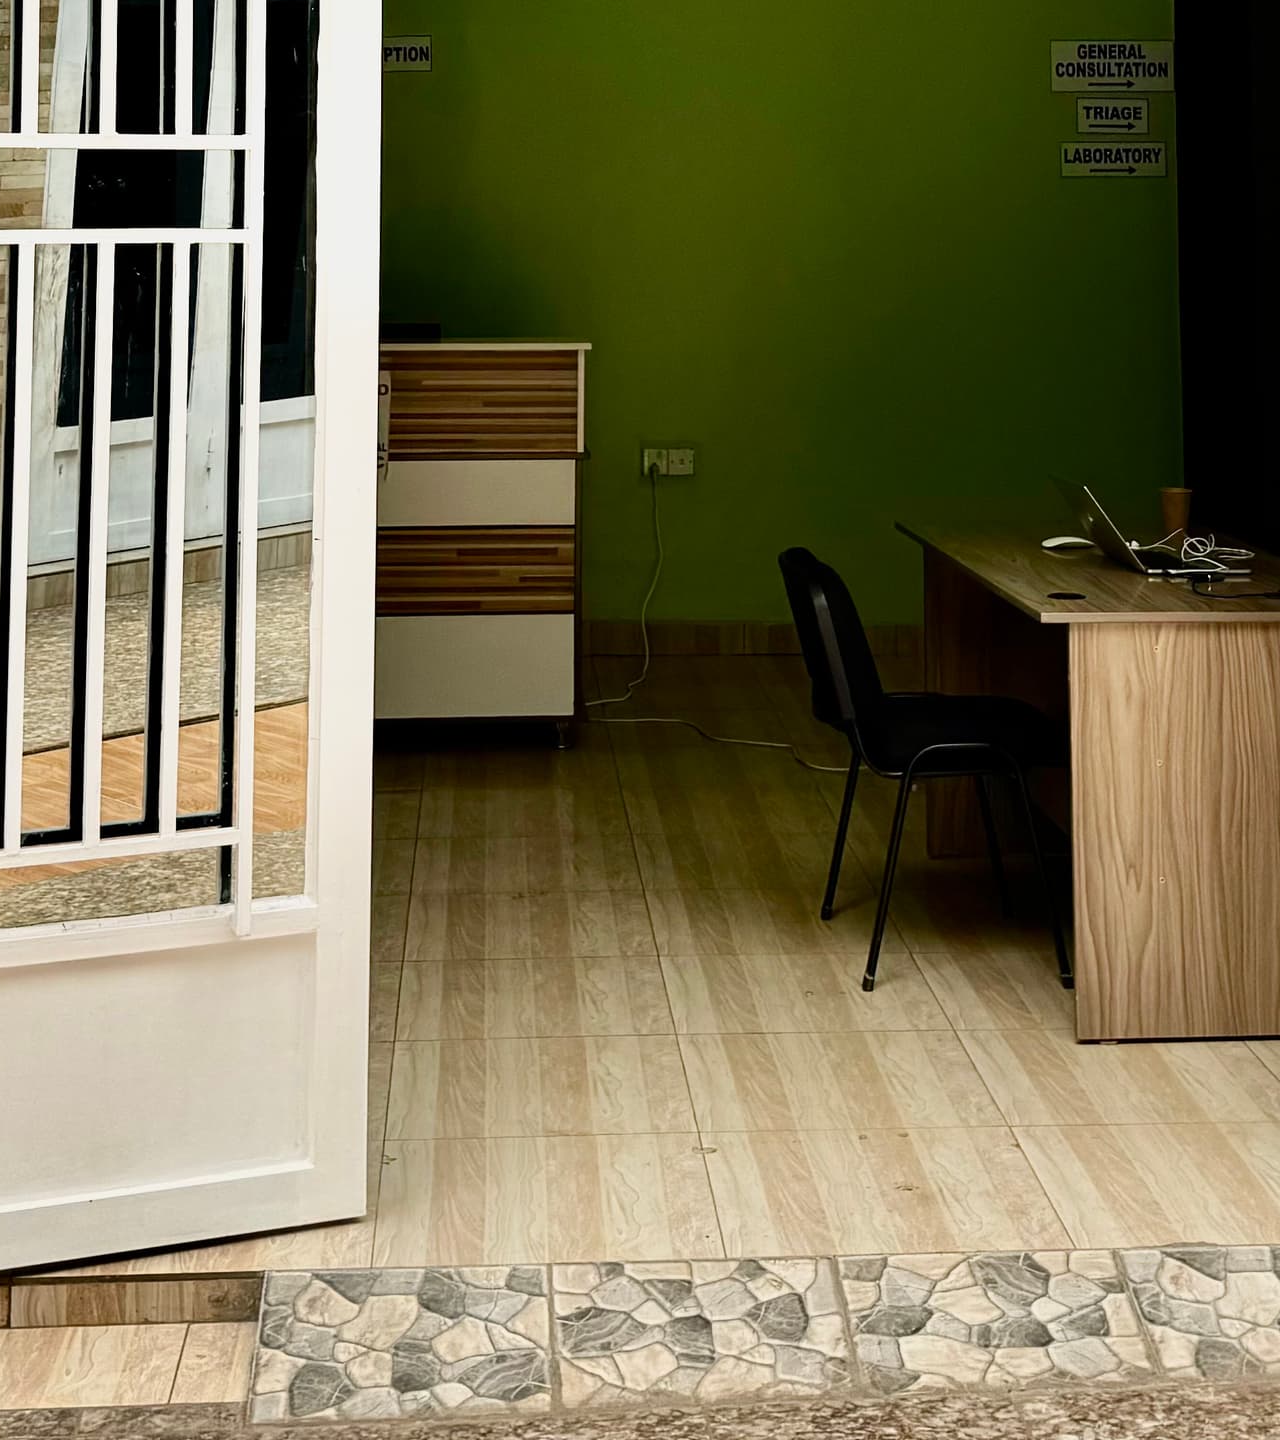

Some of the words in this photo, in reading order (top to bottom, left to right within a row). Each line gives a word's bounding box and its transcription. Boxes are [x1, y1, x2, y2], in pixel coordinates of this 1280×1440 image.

[383, 46, 430, 62] PTION
[1077, 44, 1146, 59] GENERAL
[1055, 61, 1169, 78] CONSULTATION
[1082, 106, 1143, 120] TRIAGE
[1063, 147, 1162, 164] LABORATORY
